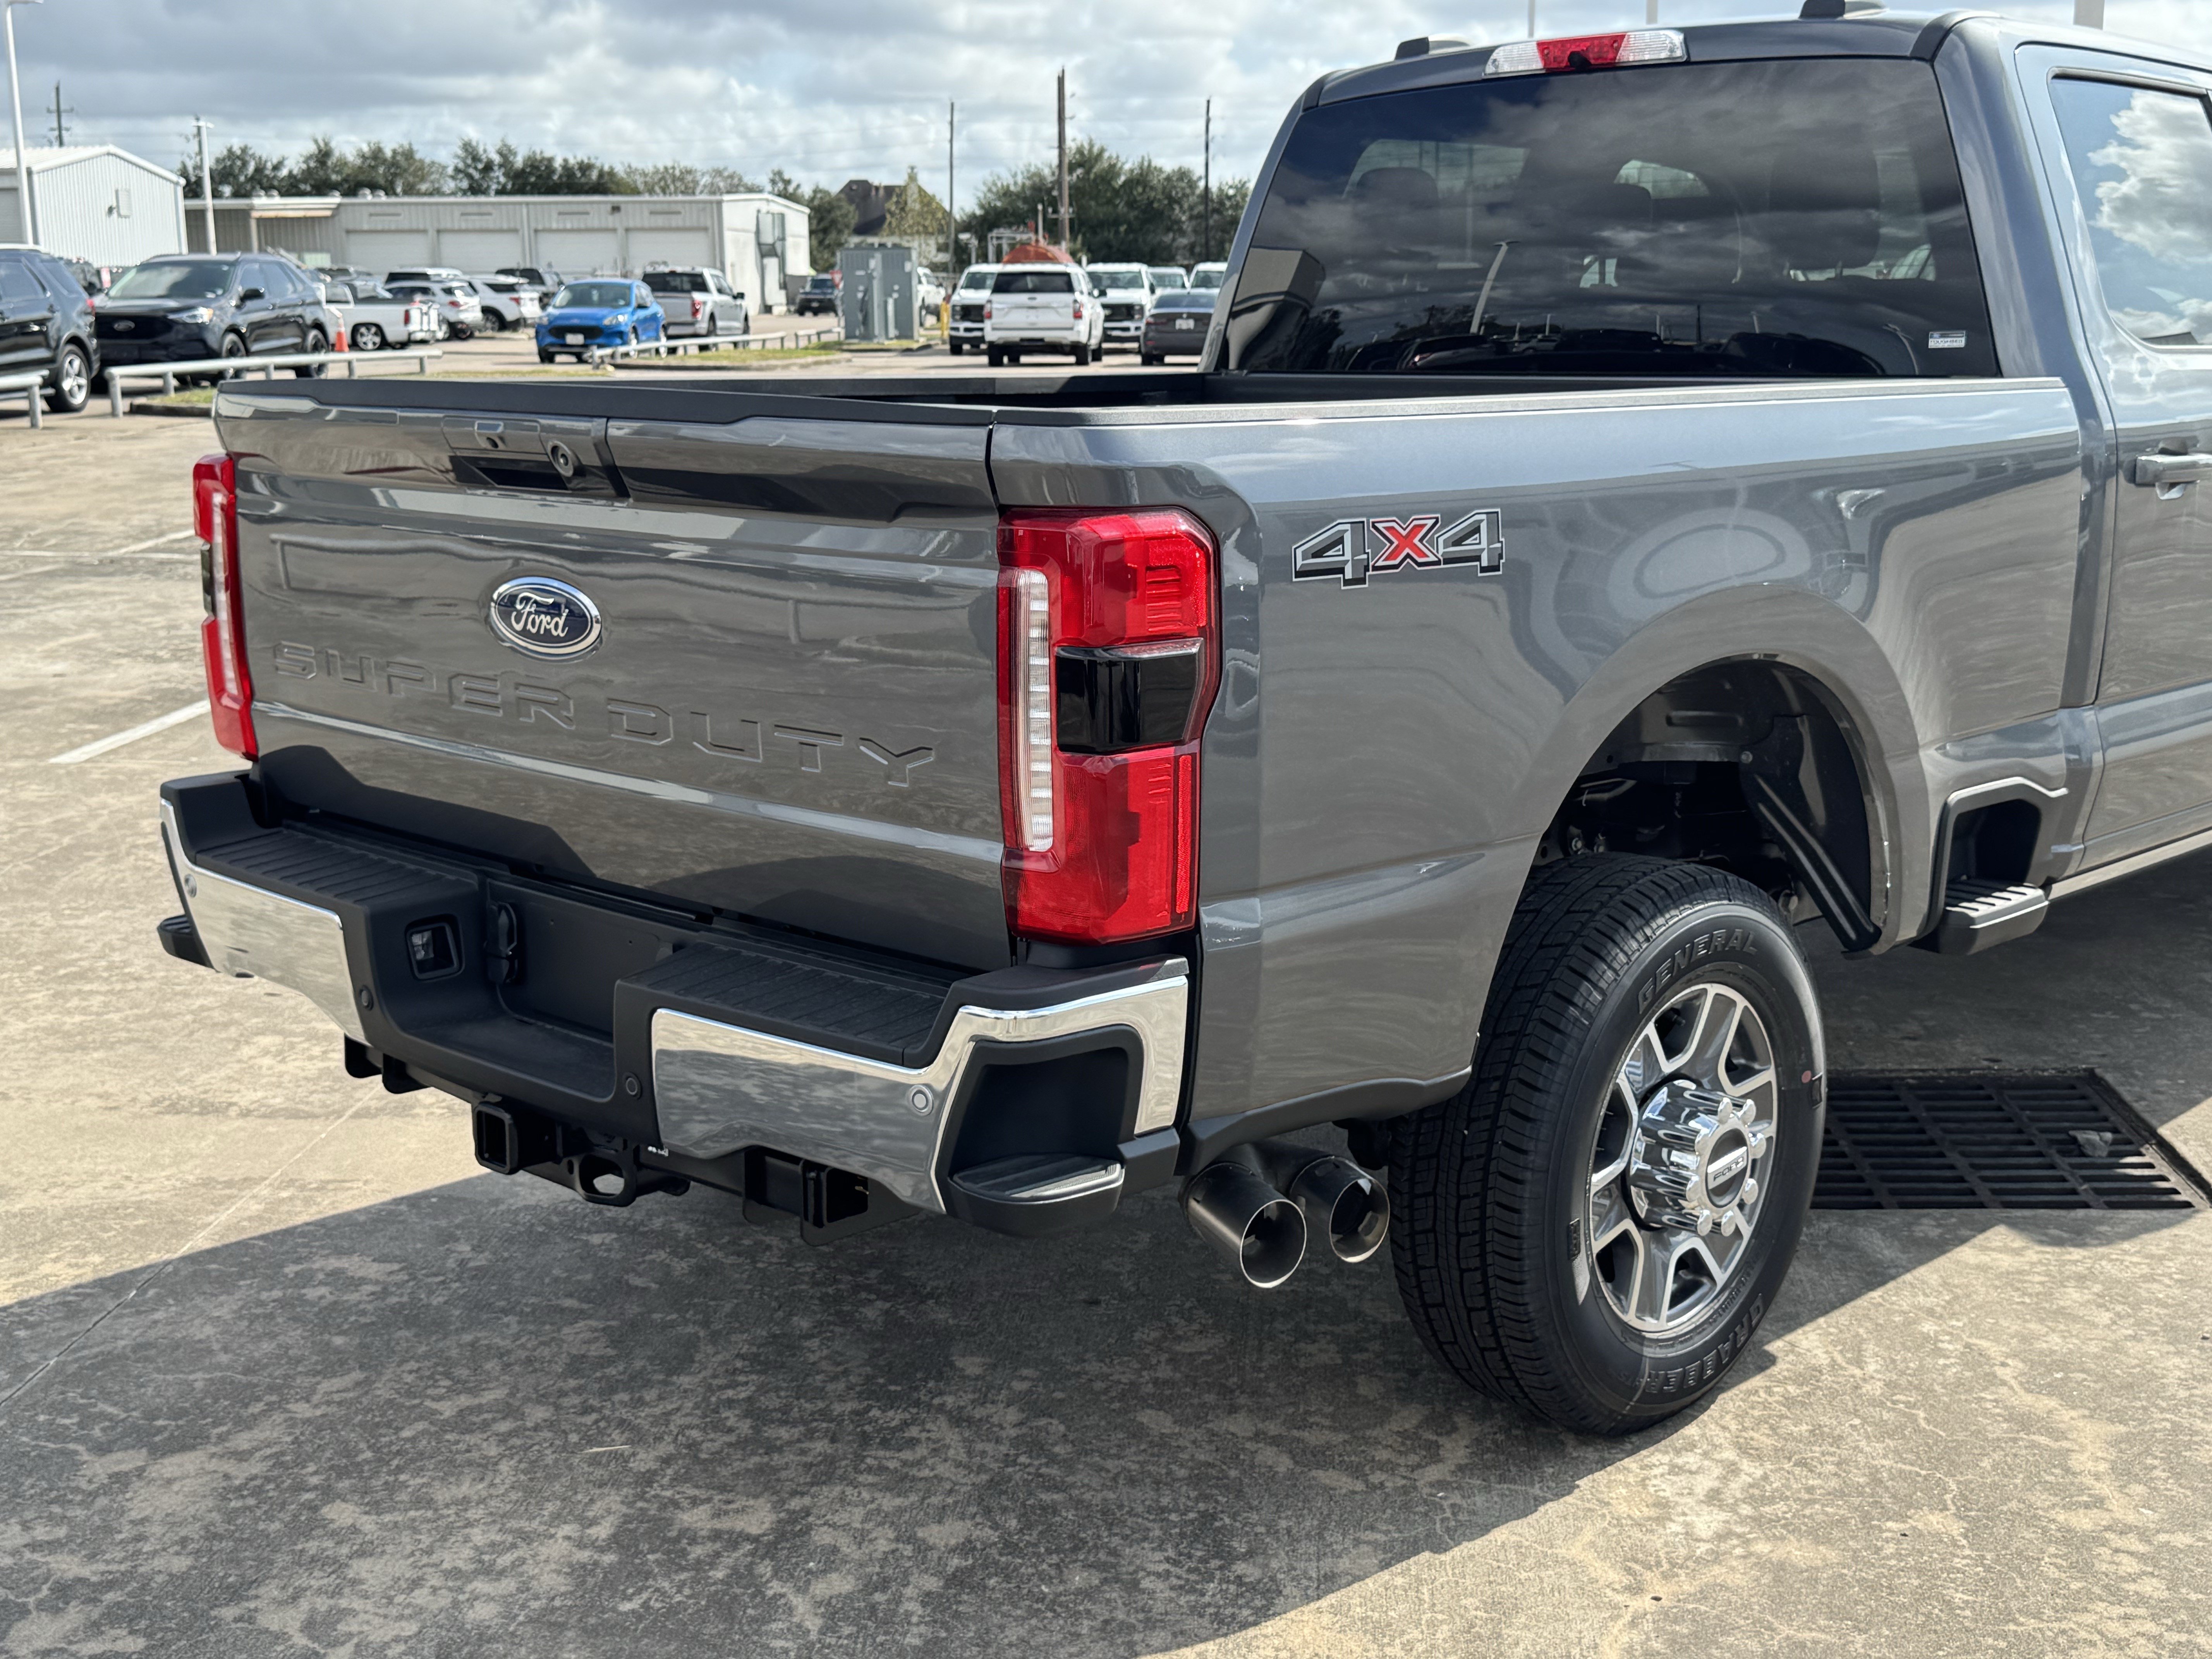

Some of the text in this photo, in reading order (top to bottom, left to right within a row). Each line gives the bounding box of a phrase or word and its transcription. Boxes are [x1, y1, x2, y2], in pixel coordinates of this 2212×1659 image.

[511, 592, 569, 637] Ford
[273, 641, 935, 787] SUPER DUTY
[1637, 929, 1758, 1014] GENERAL
[1645, 1293, 1763, 1393] GRABBER
